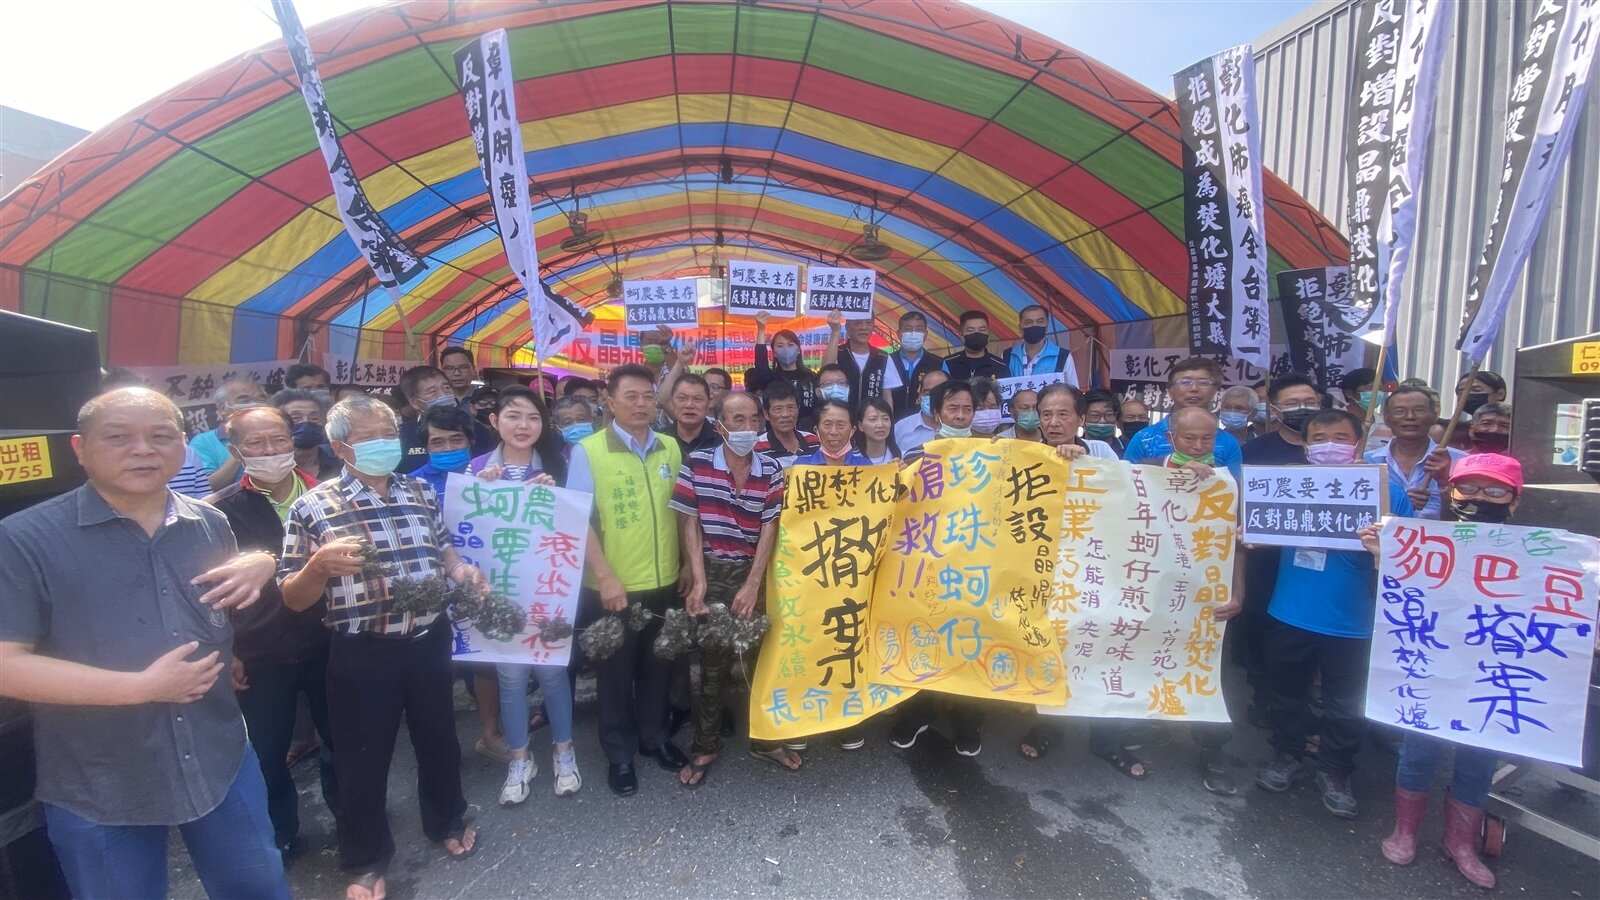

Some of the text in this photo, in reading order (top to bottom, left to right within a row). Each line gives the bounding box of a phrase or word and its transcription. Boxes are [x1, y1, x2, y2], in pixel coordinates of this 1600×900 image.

[1187, 72, 1228, 347] 拒絕成為焚化爐大縣
[1219, 58, 1263, 355] 彰化肺癌全台第一
[732, 268, 797, 287] 蚵農要生存
[811, 274, 872, 289] 蚵農要生存
[626, 286, 696, 301] 蚵農要生存
[731, 287, 795, 309] 反對晶鼎焚化爐
[810, 292, 870, 312] 反對晶鼎焚化爐
[628, 305, 696, 322] 反對晶鼎焚化爐
[1581, 345, 1600, 360] 仁
[0, 442, 42, 464] 出租
[1248, 476, 1375, 501] 蚵農要生存
[461, 481, 556, 532] 蚵農
[1247, 507, 1374, 534] 反對晶鼎焚化爐
[935, 450, 1002, 661] 珍珠蚵仔
[1099, 469, 1163, 699] 百年蚵仔煎好味道
